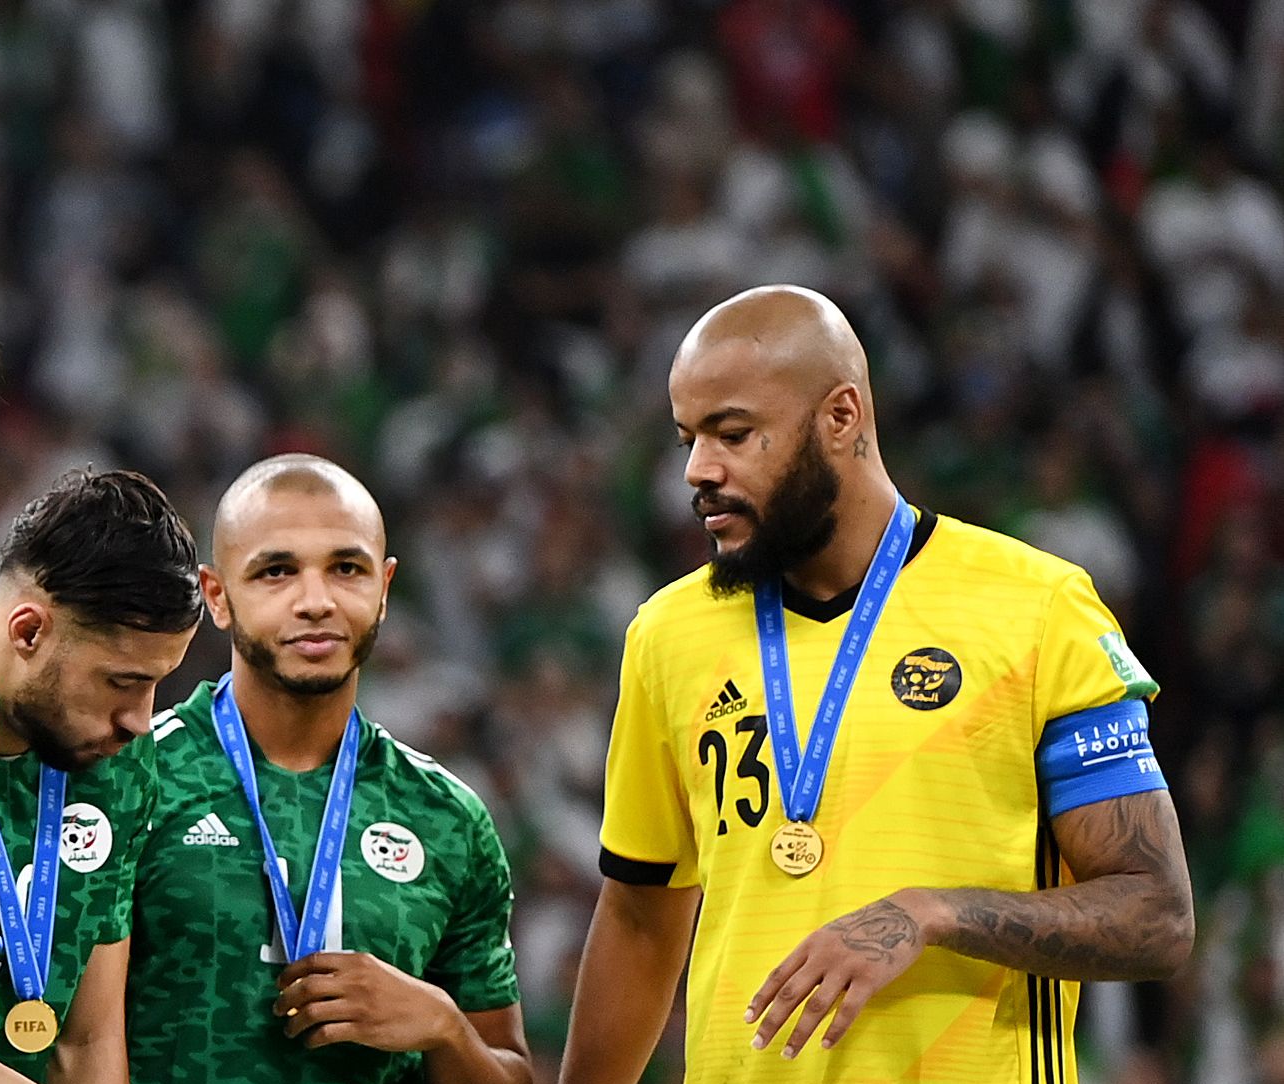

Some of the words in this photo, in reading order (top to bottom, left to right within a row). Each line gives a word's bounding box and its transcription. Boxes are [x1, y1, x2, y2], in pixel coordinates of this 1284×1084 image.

[705, 698, 748, 722] adidas
[1074, 717, 1148, 744] LIVIN
[1077, 731, 1149, 757] FOOTBA
[698, 714, 770, 836] 23
[1137, 758, 1161, 774] FIF
[183, 833, 239, 846] adidas
[36, 897, 46, 921] FIFA
[15, 941, 27, 965] FIFA
[14, 1020, 47, 1033] FIFA
